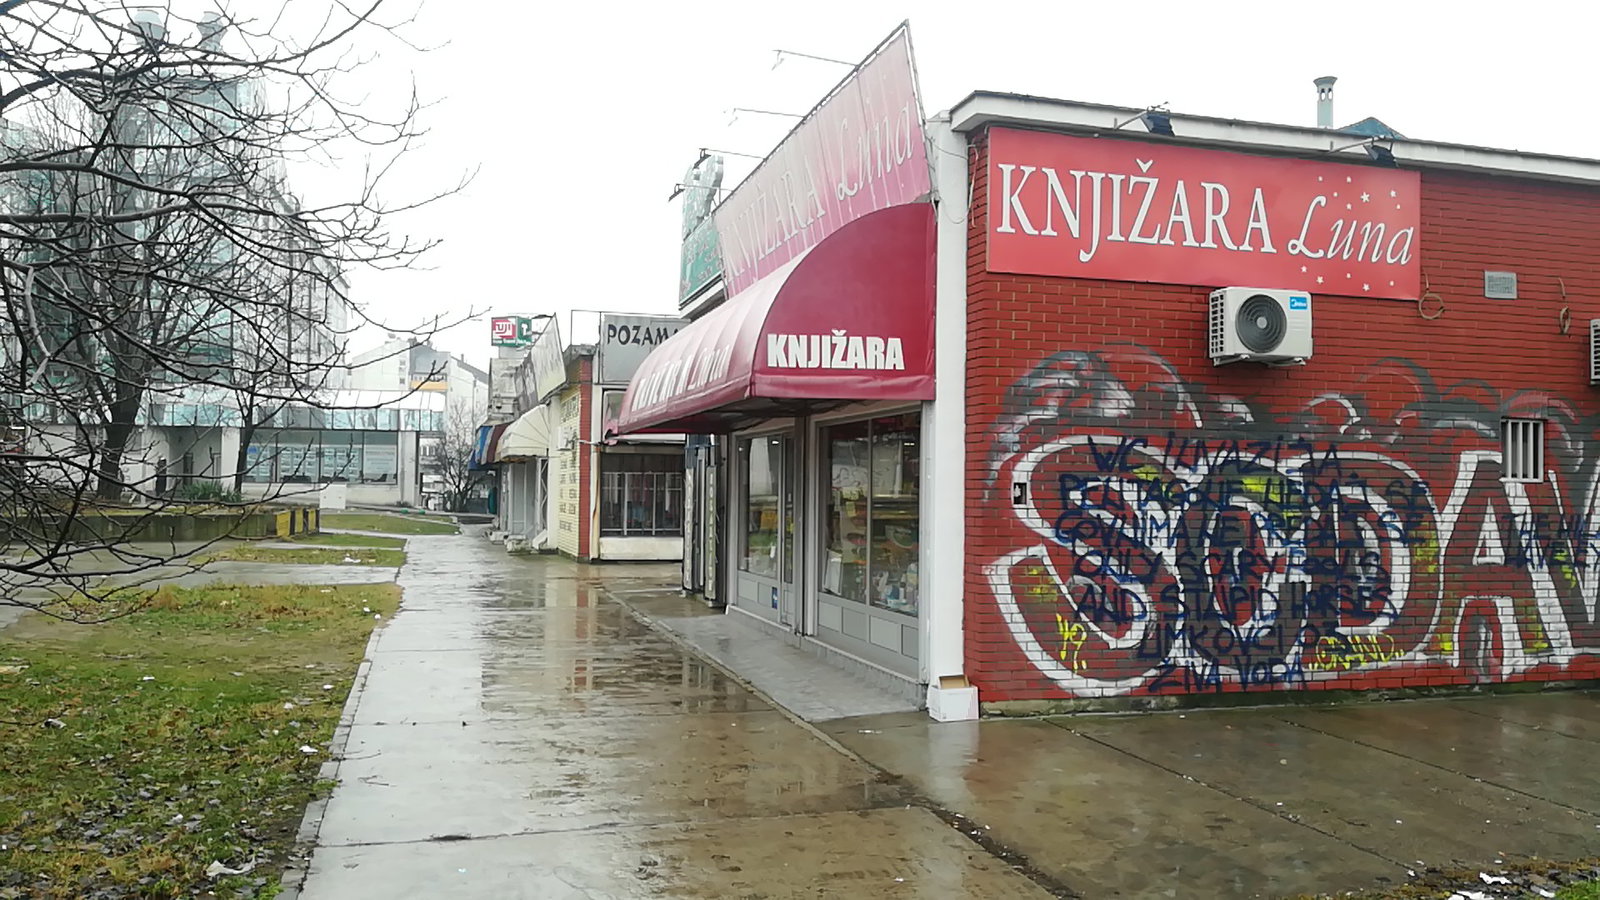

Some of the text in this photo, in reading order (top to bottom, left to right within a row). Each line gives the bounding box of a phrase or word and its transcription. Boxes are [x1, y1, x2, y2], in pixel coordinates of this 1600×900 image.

[836, 101, 914, 201] Luna
[996, 158, 1415, 266] KNJIŽARA Luna
[606, 324, 680, 347] POZAM
[767, 329, 906, 371] KNJIŽARA
[1074, 584, 1148, 624] AND
[1161, 583, 1281, 623] STUPID
